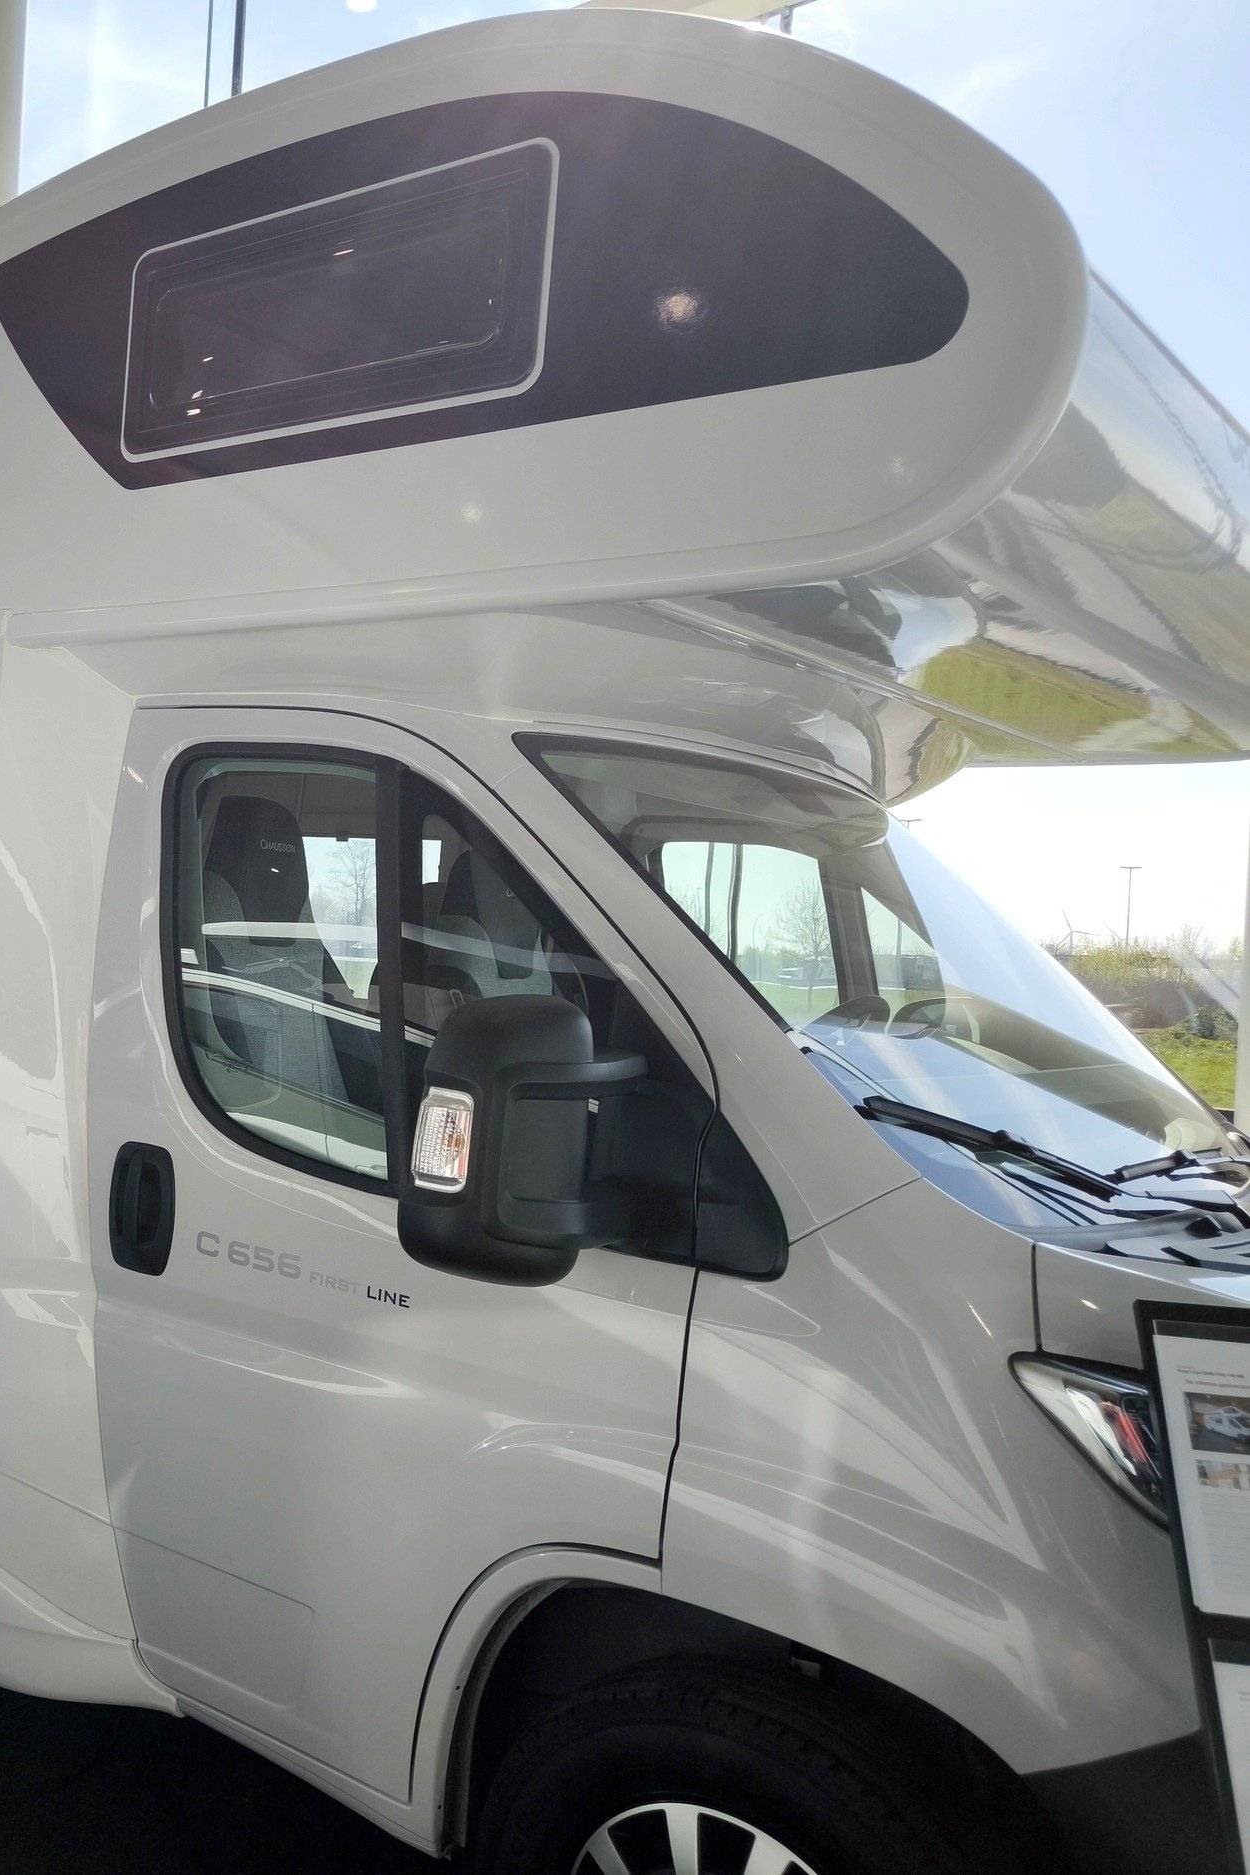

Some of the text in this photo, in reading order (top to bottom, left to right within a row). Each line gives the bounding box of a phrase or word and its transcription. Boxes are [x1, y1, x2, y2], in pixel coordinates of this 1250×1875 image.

[227, 1240, 302, 1280] 656
[309, 1271, 362, 1295] FIRST
[366, 1285, 410, 1309] LINE
